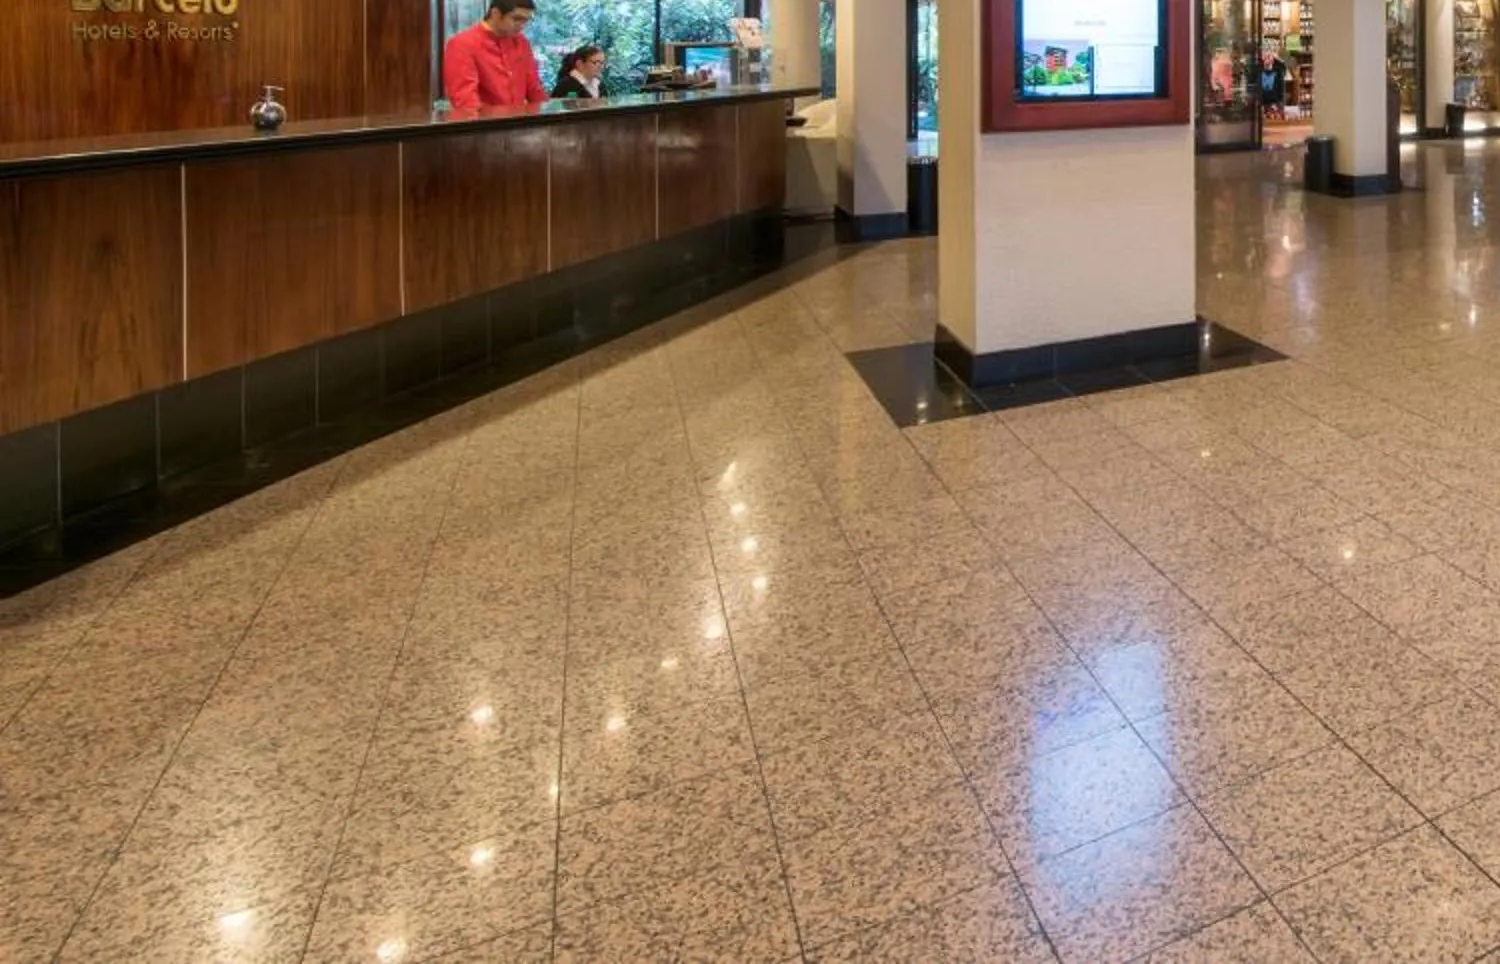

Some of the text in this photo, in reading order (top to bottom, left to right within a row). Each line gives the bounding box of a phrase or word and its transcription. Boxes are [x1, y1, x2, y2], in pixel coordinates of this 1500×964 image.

[72, 19, 234, 41] Hotels & Resorts
